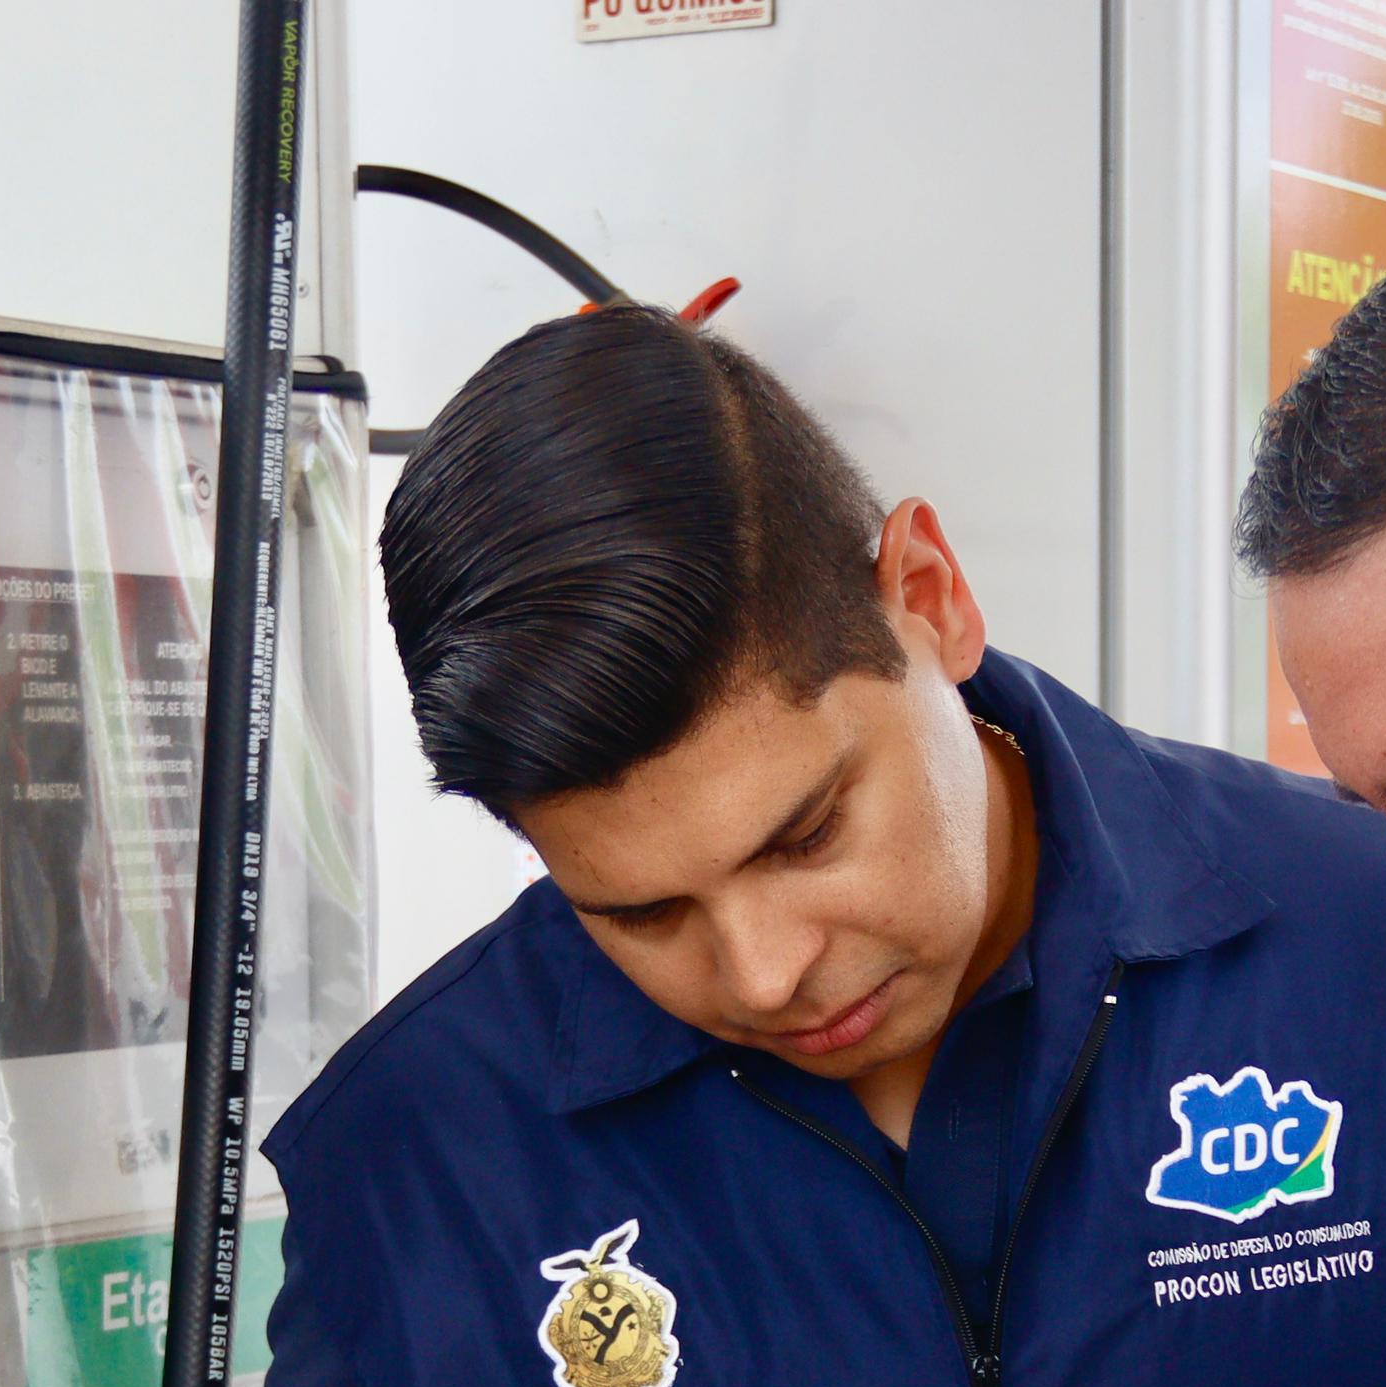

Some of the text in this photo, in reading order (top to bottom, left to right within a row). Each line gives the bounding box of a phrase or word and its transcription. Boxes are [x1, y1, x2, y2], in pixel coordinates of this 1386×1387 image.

[275, 86, 296, 183] RECOVERY
[267, 266, 291, 351] MH65061
[241, 832, 262, 878] DN19
[229, 987, 252, 1070] 19.05mm
[225, 1097, 244, 1124] WP
[219, 1137, 241, 1214] 10.5MPa
[1200, 1117, 1300, 1175] CDC
[213, 1227, 235, 1301] 1520PSI
[1213, 1243, 1229, 1259] DE
[1274, 1232, 1293, 1251] DO
[1295, 1220, 1371, 1247] CONSUMIDOR
[1154, 1250, 1374, 1308] PROCON LEGISLATIVO
[207, 1313, 228, 1380] 105BAR
